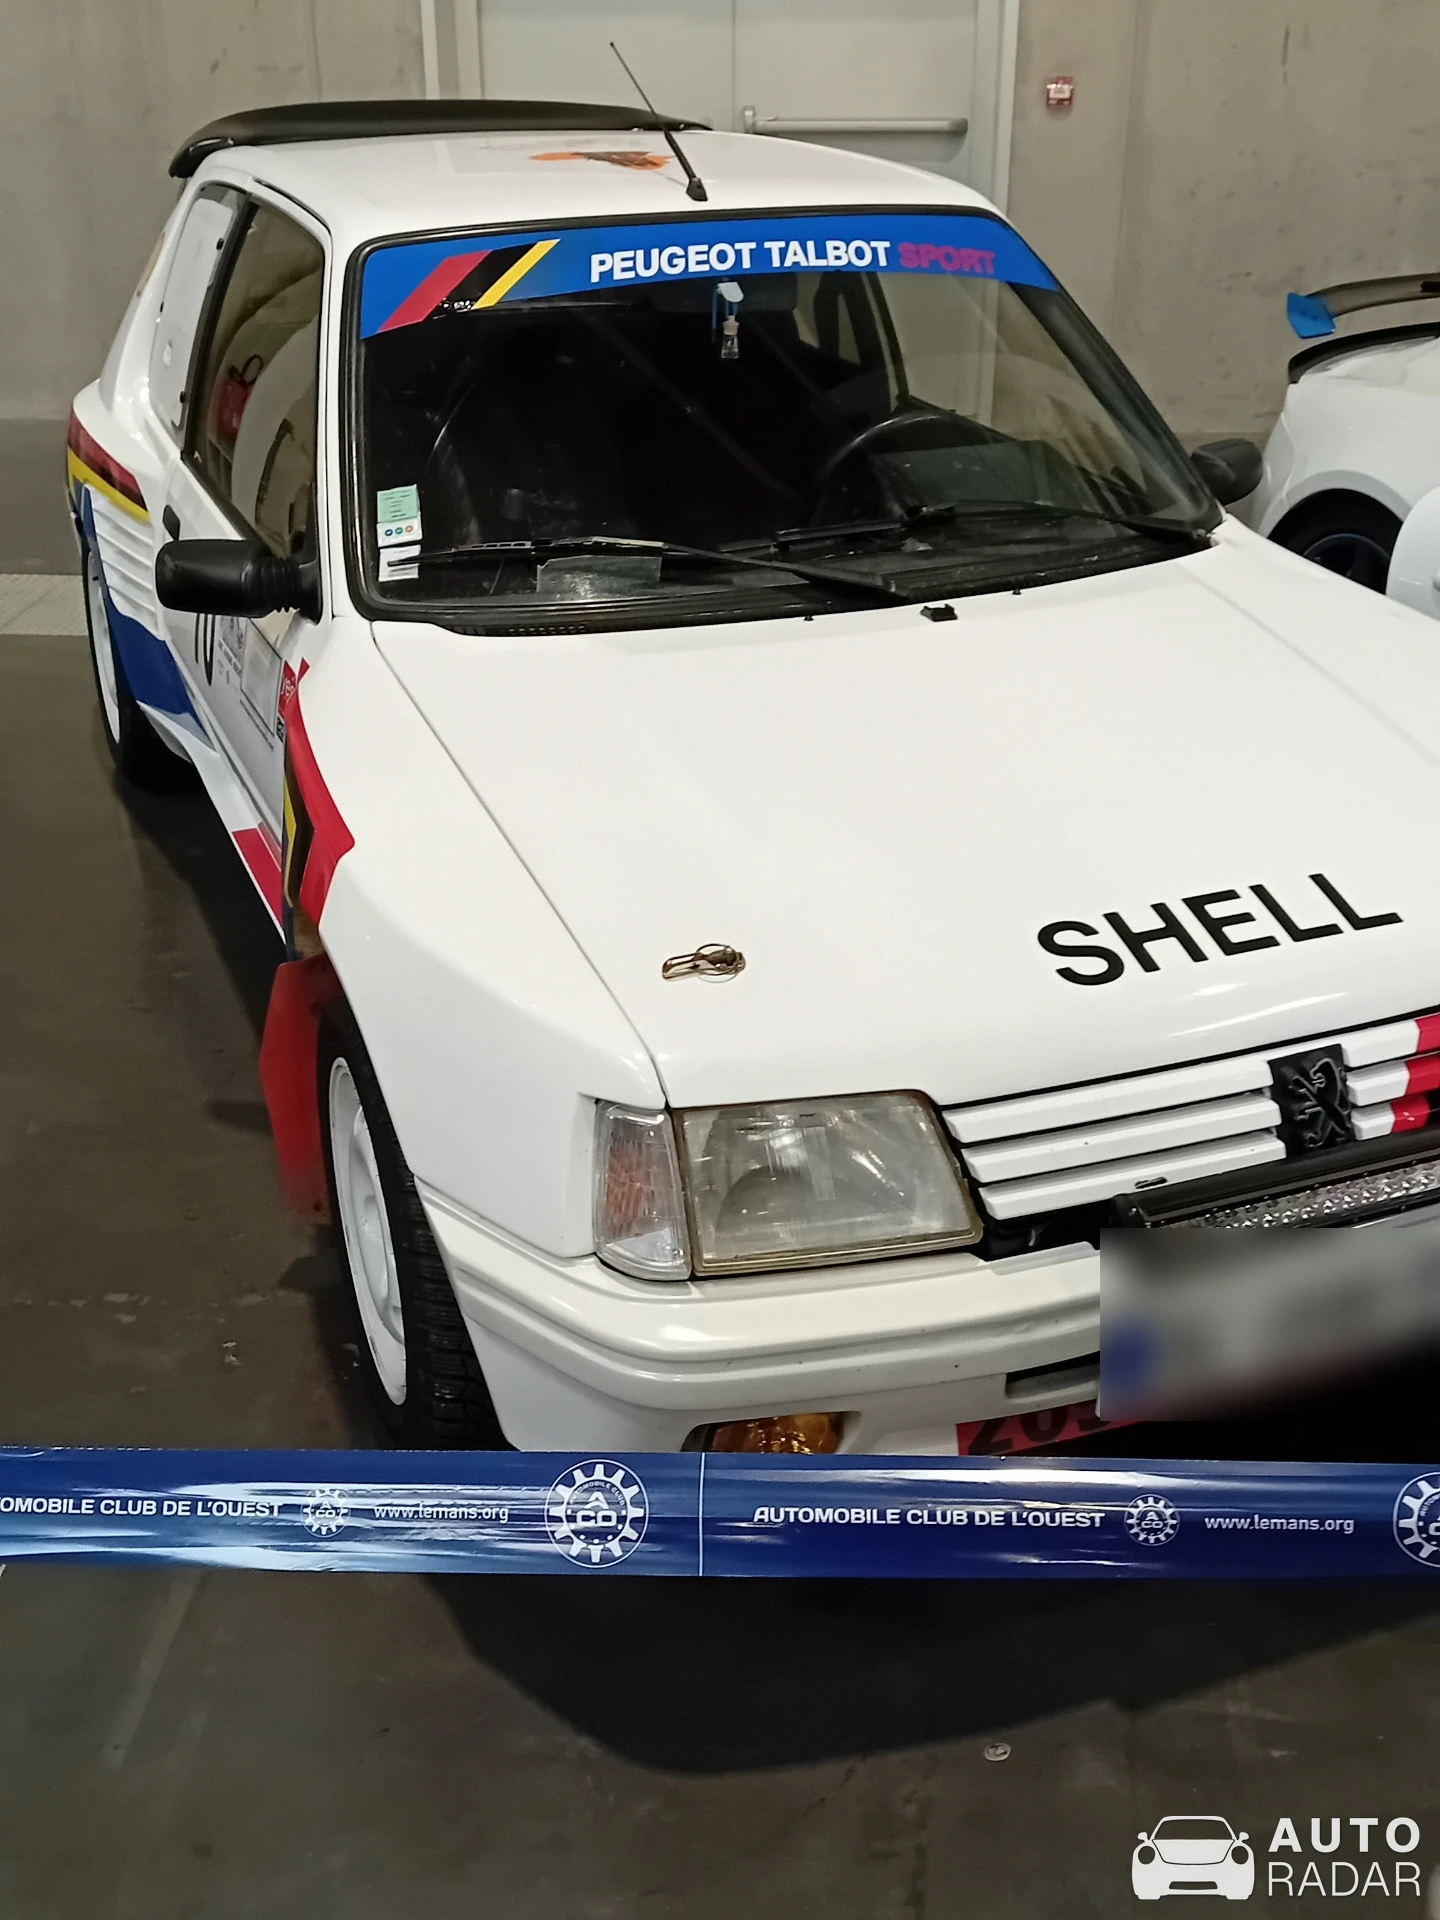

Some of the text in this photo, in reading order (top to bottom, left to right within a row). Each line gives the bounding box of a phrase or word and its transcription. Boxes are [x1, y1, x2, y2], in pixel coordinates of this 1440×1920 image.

[590, 239, 996, 283] PEUGEOT TALBOT SPORT
[1037, 873, 1403, 986] SHELL
[0, 1496, 96, 1515] OMOBILE
[100, 1499, 157, 1516] CLUB
[162, 1500, 191, 1517] DE
[374, 1501, 509, 1523] www.lemans.org
[753, 1506, 1106, 1528] AUTOMOBILE CLUB DE L'OUEST
[1204, 1514, 1355, 1534] www.lemans.org
